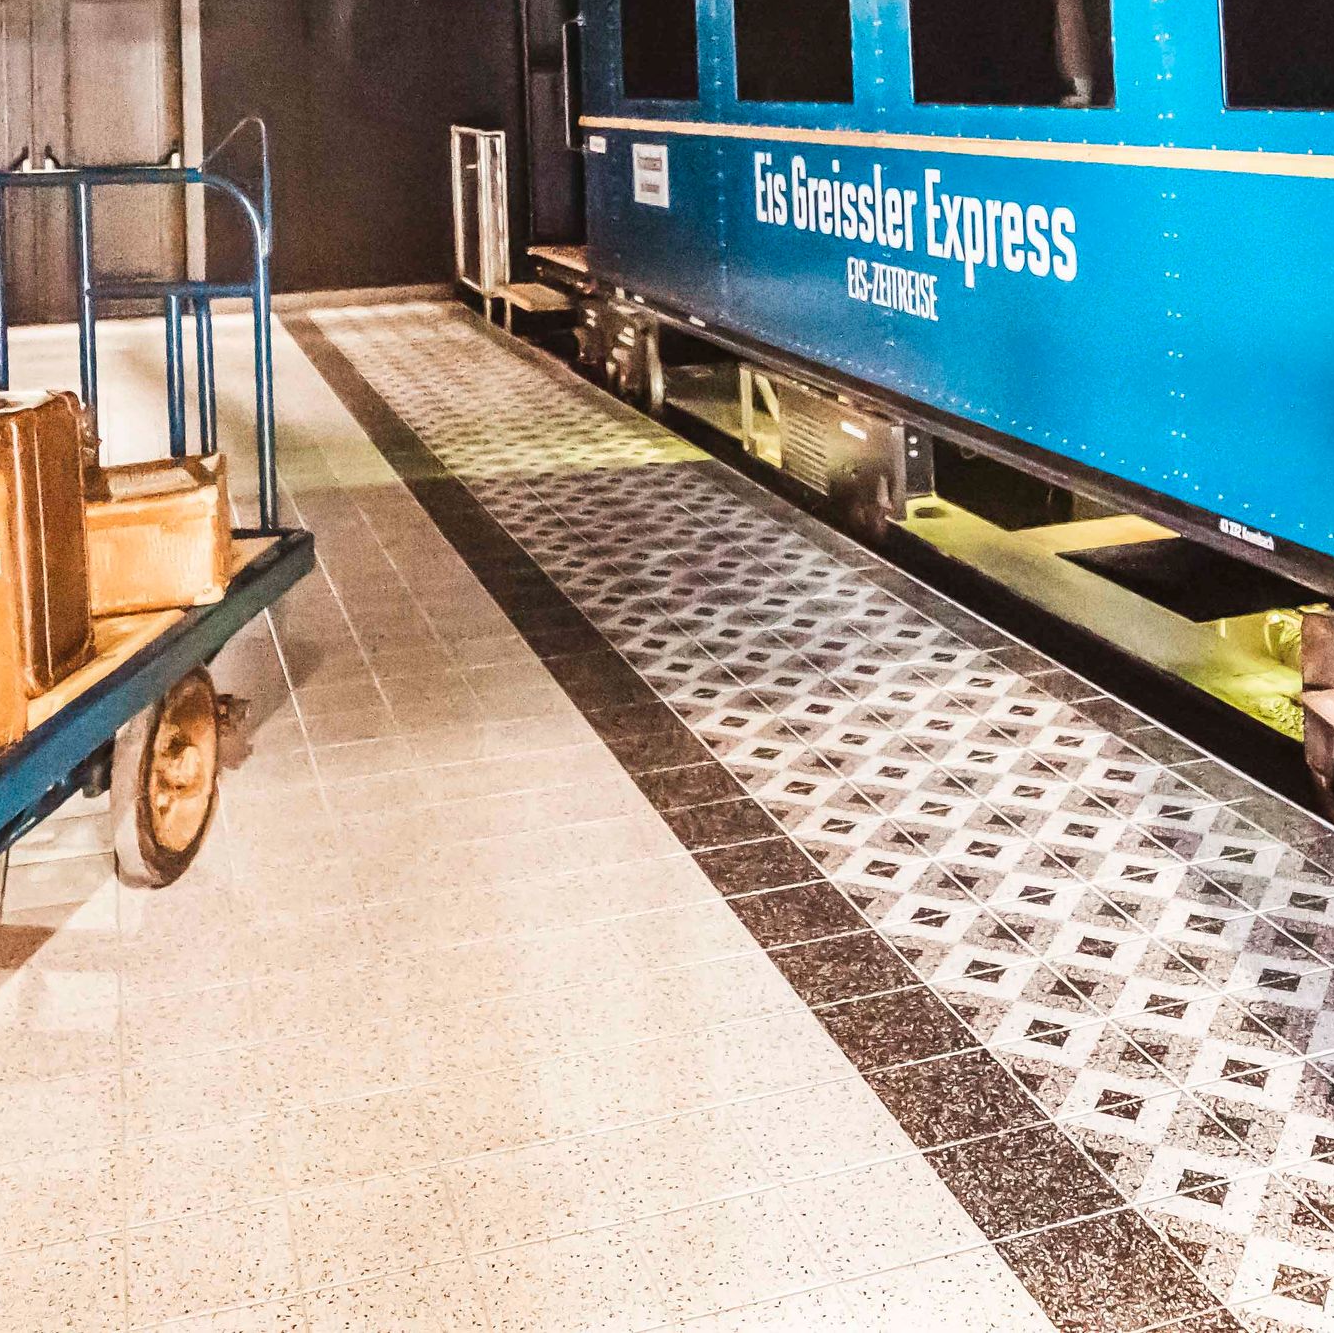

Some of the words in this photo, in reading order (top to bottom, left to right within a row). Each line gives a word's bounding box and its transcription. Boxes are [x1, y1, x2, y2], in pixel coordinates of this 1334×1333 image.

[754, 151, 788, 226] Eis
[791, 155, 917, 251] Greissler
[925, 168, 1078, 288] Express
[847, 256, 939, 321] EIS-ZEITREISE
